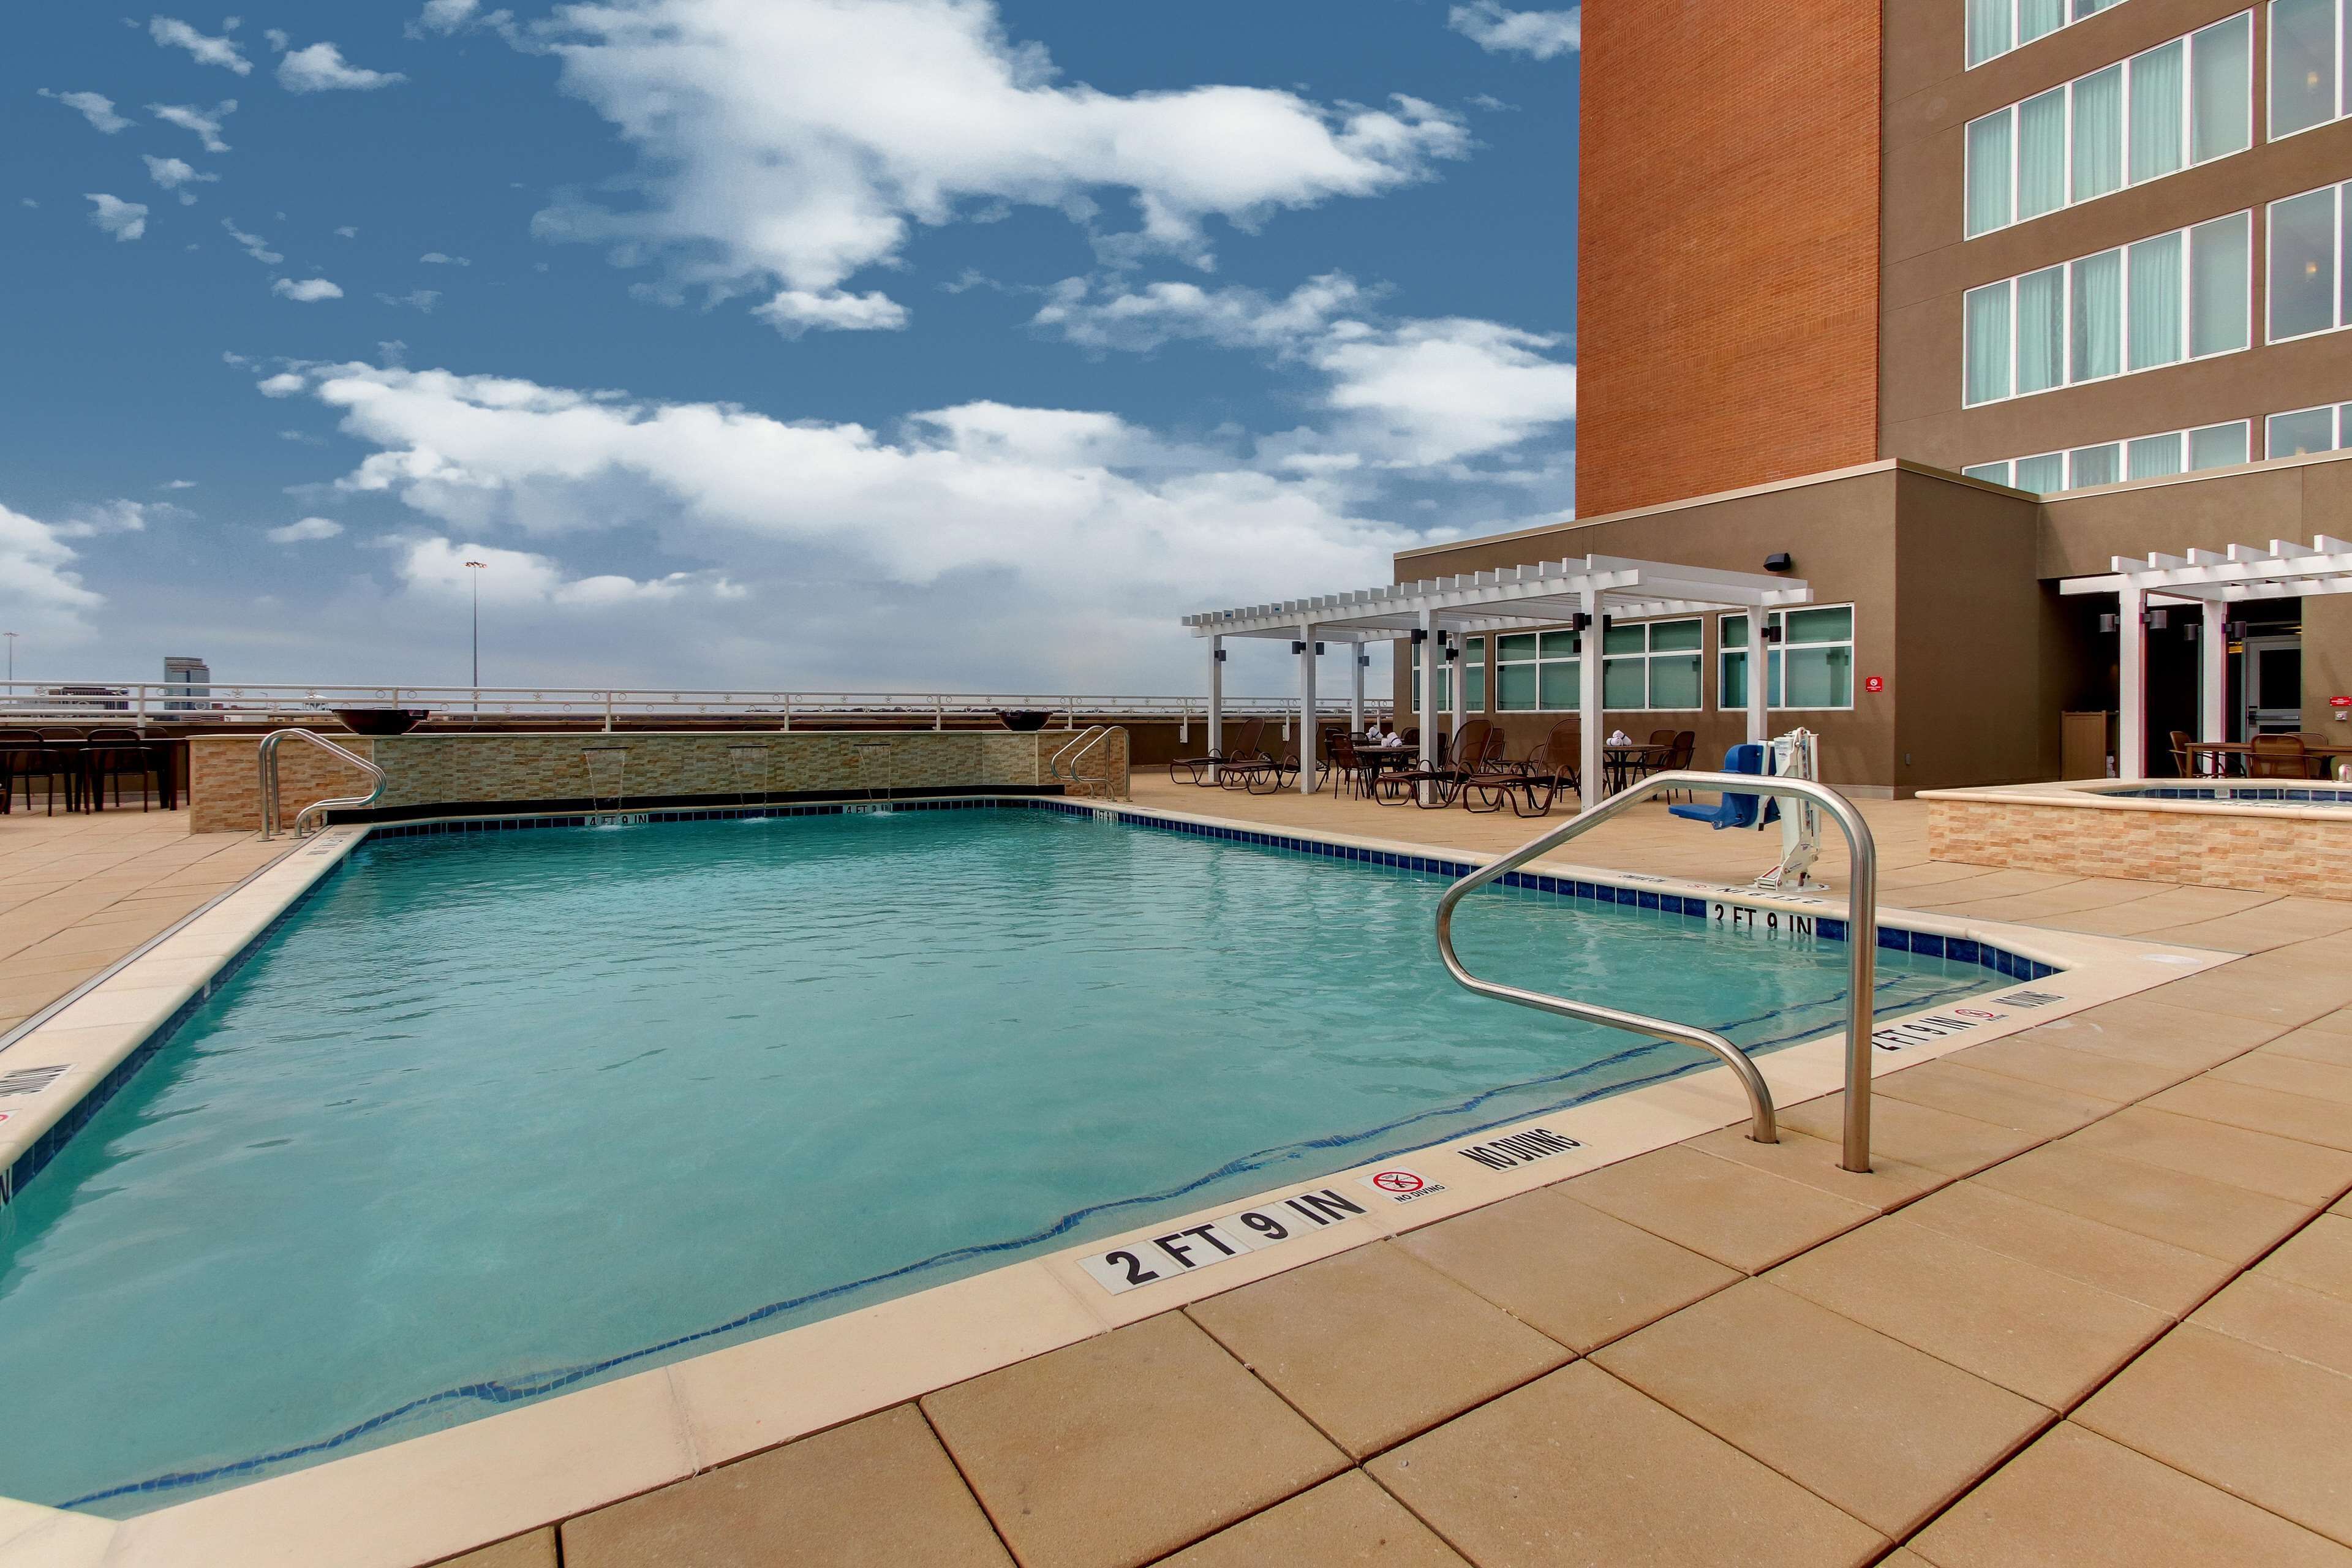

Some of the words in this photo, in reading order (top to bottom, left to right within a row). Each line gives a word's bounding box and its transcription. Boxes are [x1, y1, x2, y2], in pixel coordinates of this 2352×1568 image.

[846, 805, 852, 814] 4
[856, 805, 867, 813] FT
[1099, 810, 1104, 819] FT
[1111, 812, 1117, 820] IN
[590, 816, 597, 826] 4
[634, 814, 647, 824] IN
[1714, 903, 1724, 920] 2
[1733, 906, 1757, 926] FT
[1766, 911, 1777, 929] 9
[1789, 914, 1811, 935] IN
[1902, 1024, 1948, 1035] 9
[1918, 1016, 1979, 1030] IN
[1871, 1029, 1930, 1046] FT
[1487, 1128, 1581, 1162] DIVING
[1457, 1145, 1519, 1170] NO
[1393, 1194, 1412, 1202] NO
[1409, 1184, 1446, 1197] DIVING
[1105, 1251, 1161, 1286] 2
[1152, 1223, 1237, 1268] FT
[1240, 1212, 1289, 1240] 9
[1284, 1189, 1368, 1226] IN
